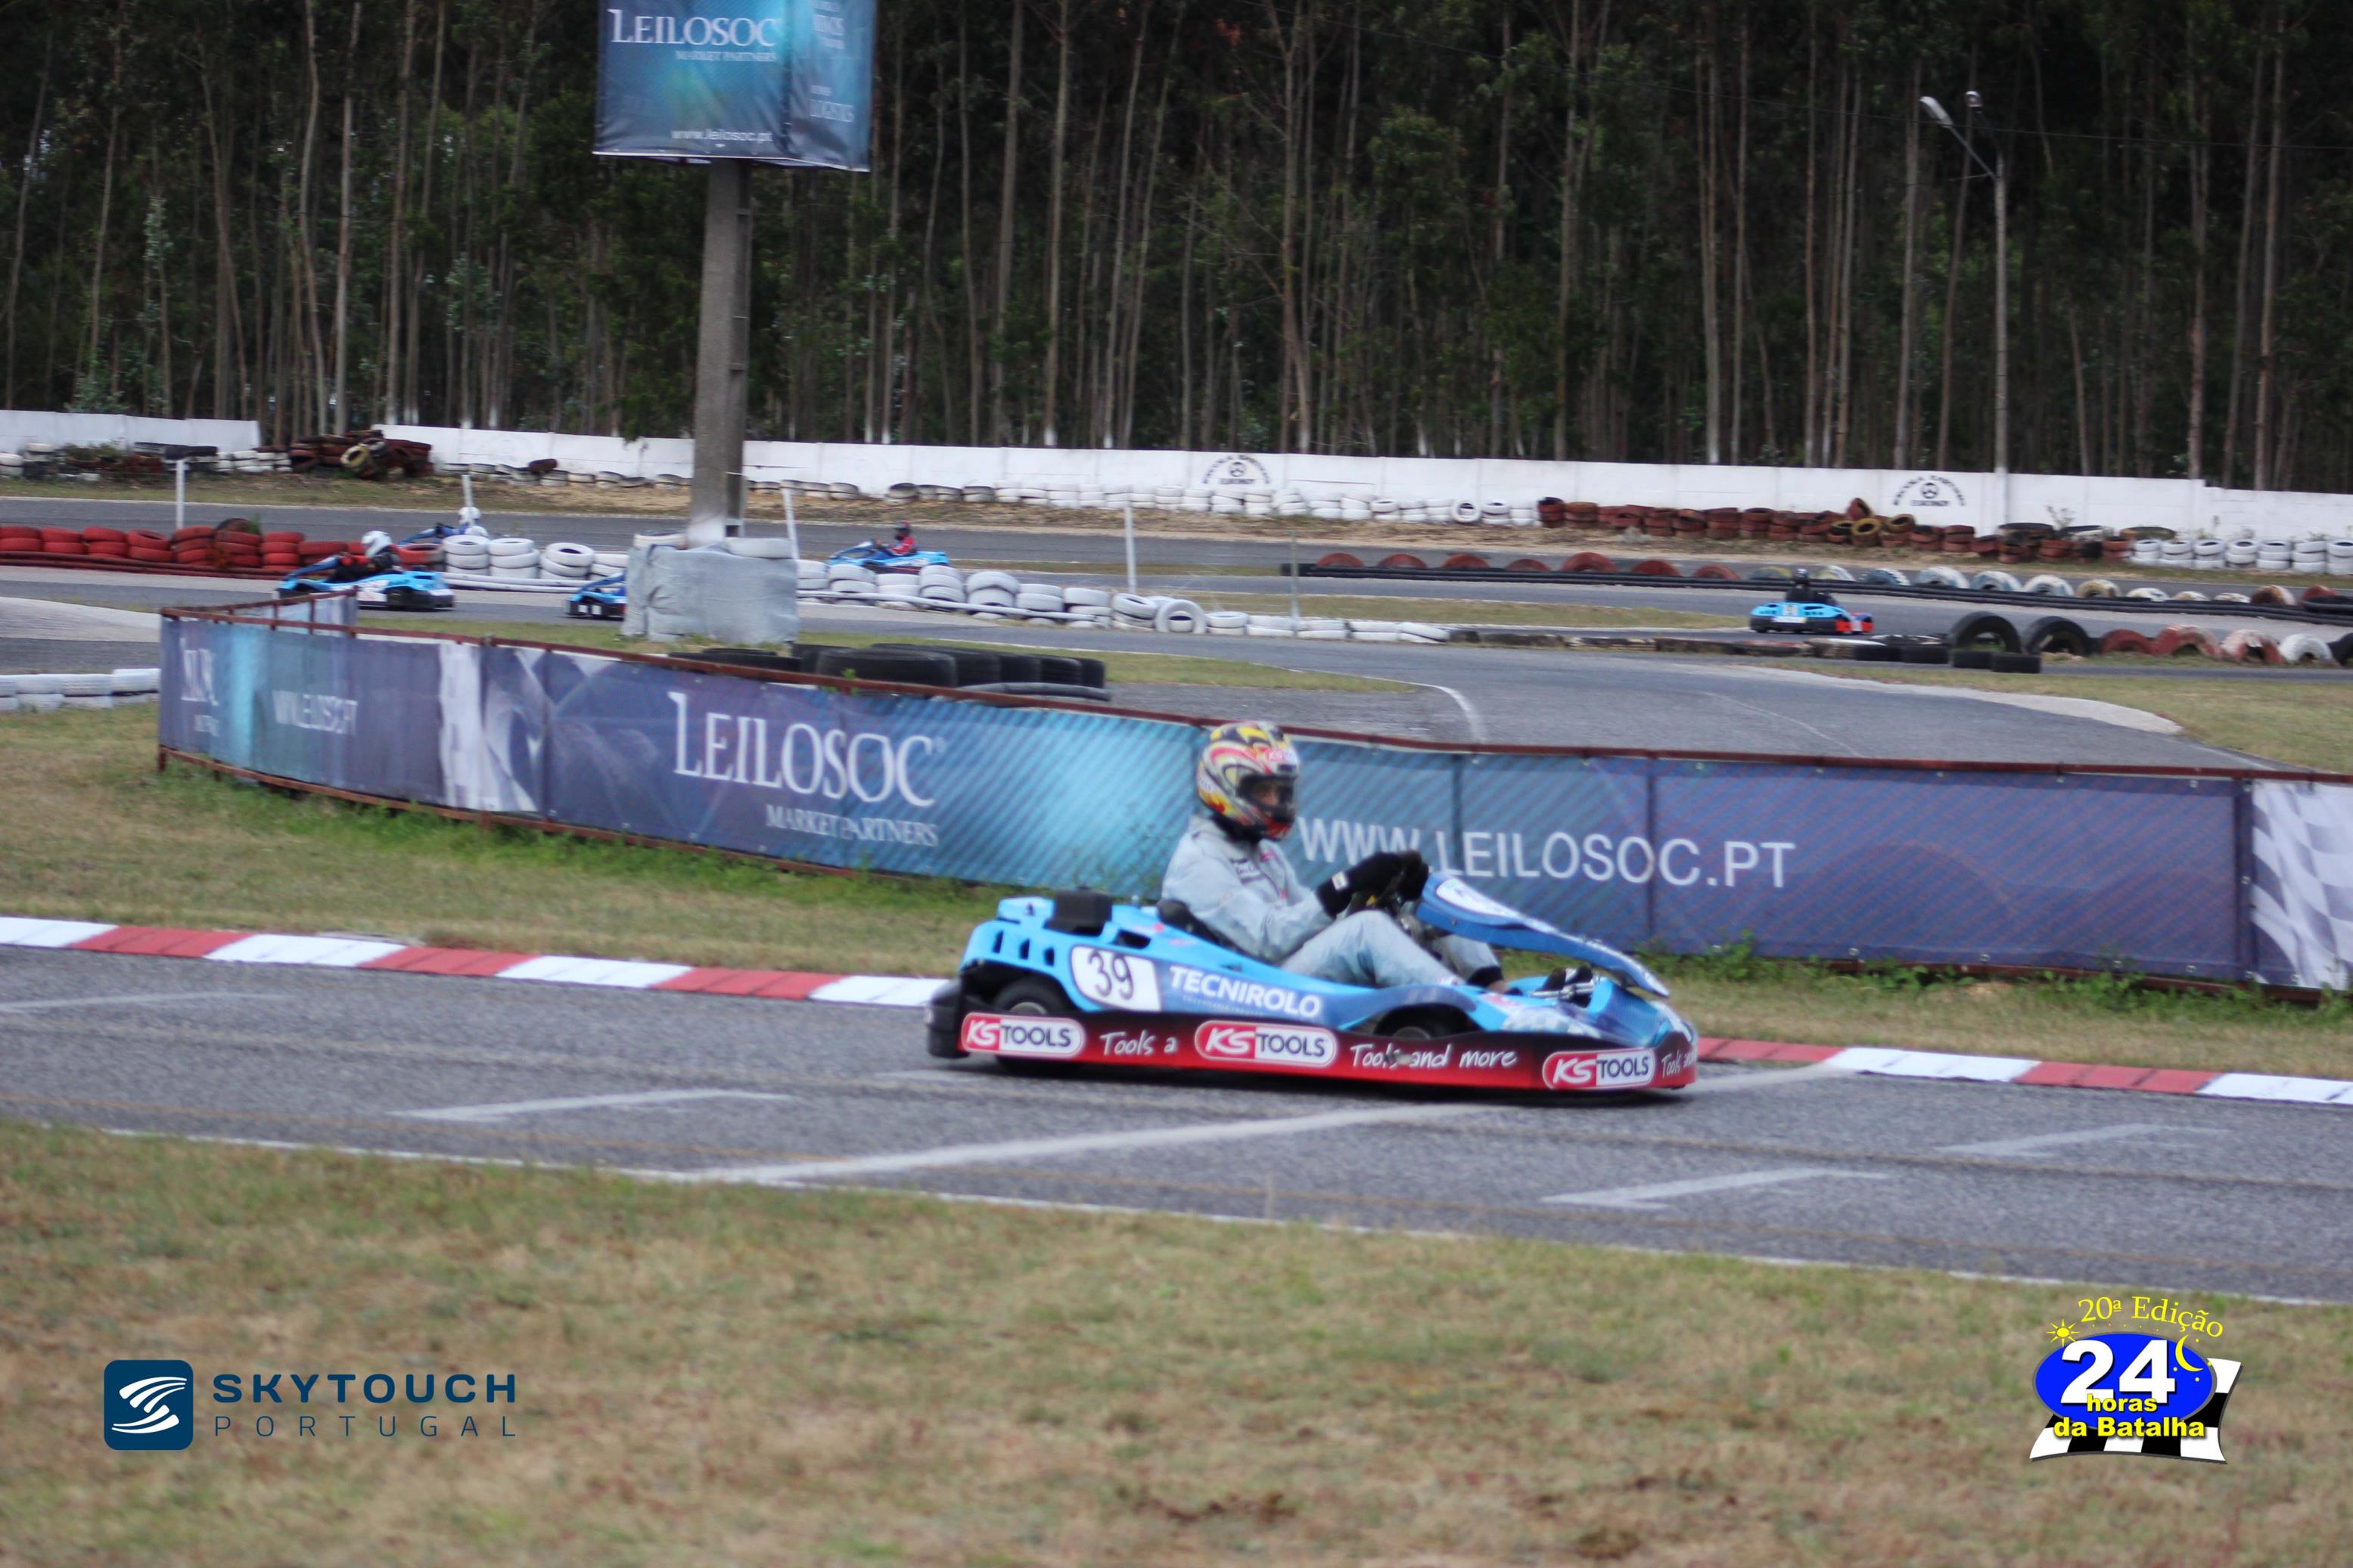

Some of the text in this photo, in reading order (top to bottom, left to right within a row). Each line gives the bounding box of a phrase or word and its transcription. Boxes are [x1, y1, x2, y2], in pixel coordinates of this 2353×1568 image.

[608, 8, 777, 47] LEILOSOC
[667, 691, 935, 807] LEILOSOC
[766, 804, 939, 846] MARKET PARTNERS
[1086, 949, 1134, 1000] 39
[1169, 965, 1322, 1018] TECNIROLO
[1000, 1024, 1072, 1048] TOOLS
[1099, 1029, 1177, 1056] Tools a
[1256, 1032, 1325, 1057] TOOLS
[1408, 1043, 1451, 1069] and
[1459, 1050, 1518, 1068] more
[1596, 1056, 1649, 1079] TOOLS
